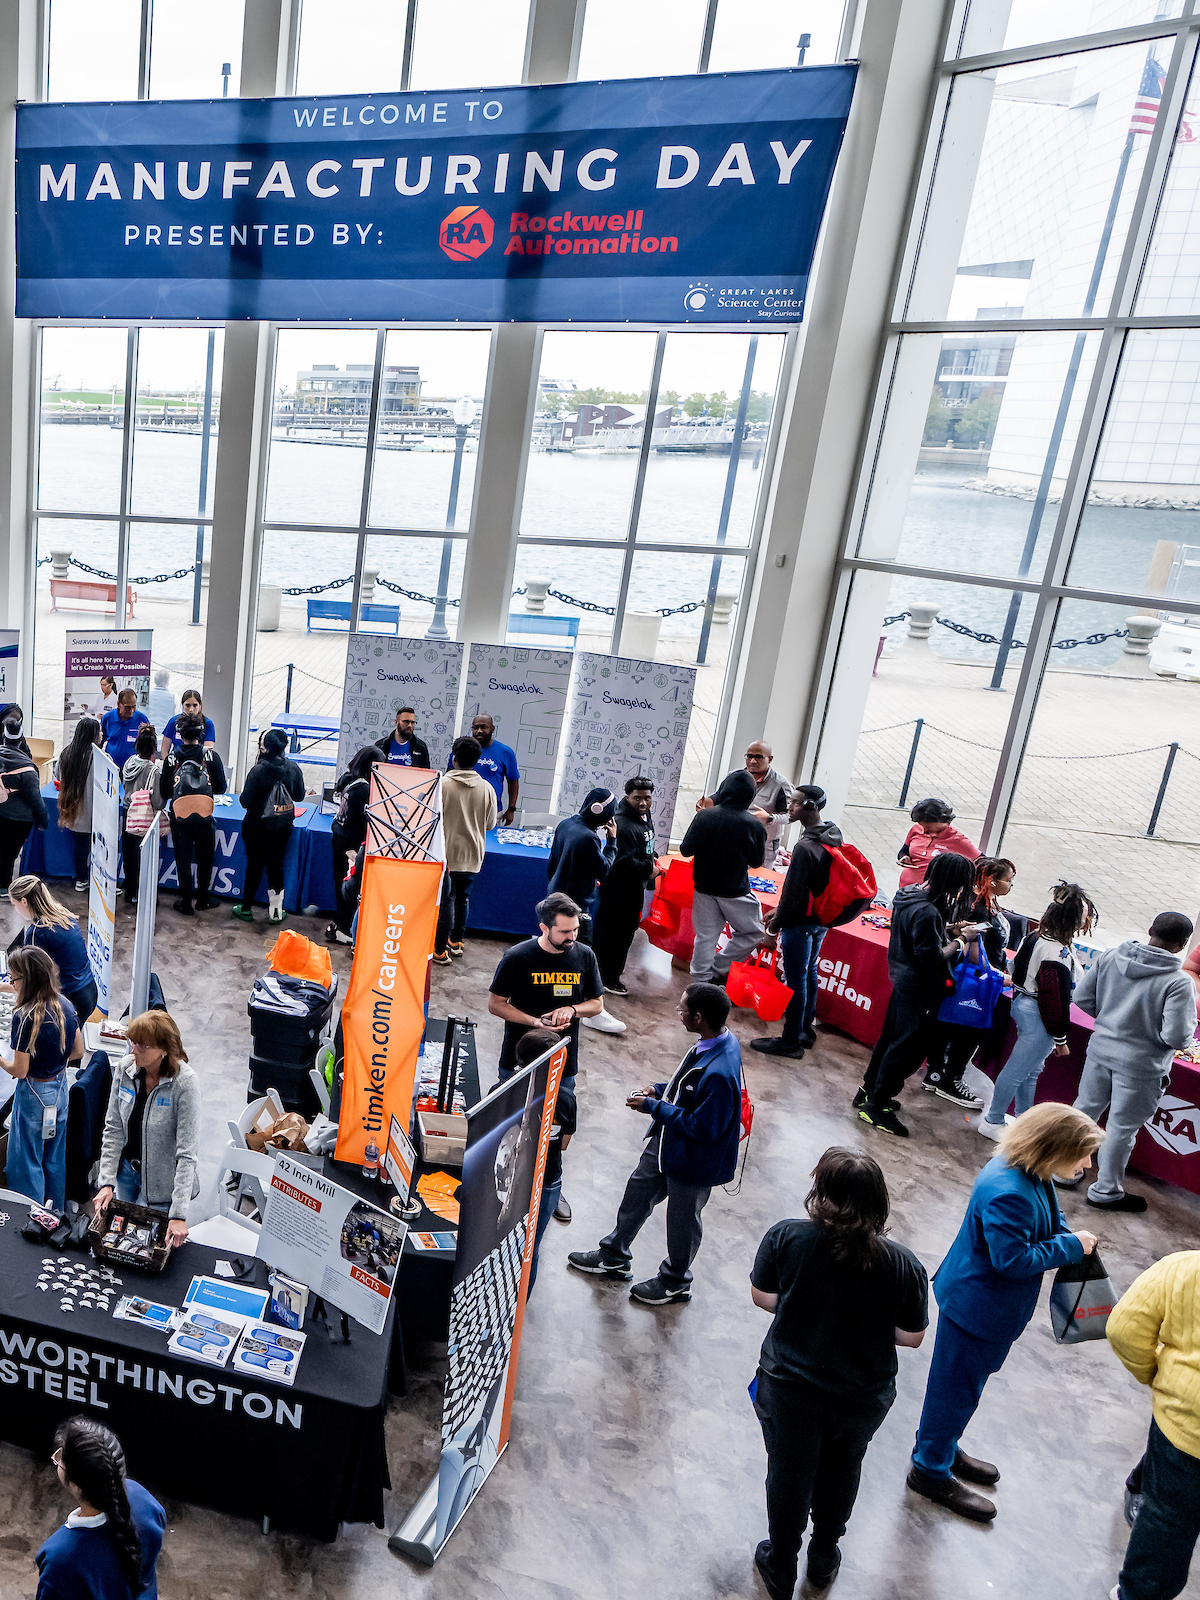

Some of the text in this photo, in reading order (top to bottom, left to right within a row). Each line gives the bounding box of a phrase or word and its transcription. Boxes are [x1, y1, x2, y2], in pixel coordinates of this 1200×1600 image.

[293, 100, 503, 128] WELCOME TO
[38, 138, 813, 202] MANUFACTURING DAY
[510, 209, 644, 234] Rockwell
[124, 222, 384, 247] PRESENTED BY:
[504, 233, 679, 256] Automation
[717, 297, 803, 308] Science Center
[719, 288, 795, 296] GREAT LAKES
[757, 310, 772, 318] Stay
[103, 656, 112, 664] for
[112, 657, 125, 665] you
[376, 668, 428, 685] Swagelok
[488, 677, 544, 695] Swagelok
[346, 696, 387, 710] STEM
[602, 690, 656, 711] Swagelok
[570, 717, 611, 735] STEM
[531, 972, 582, 985] TIMKEN
[362, 903, 406, 1132] timken.com/careers
[1151, 1106, 1198, 1145] RA
[523, 1052, 565, 1263] The Timken Company
[278, 1159, 291, 1174] 42
[315, 1179, 337, 1198] Mill
[272, 1178, 318, 1211] ATTRIBUTES
[354, 1270, 381, 1291] FACTS
